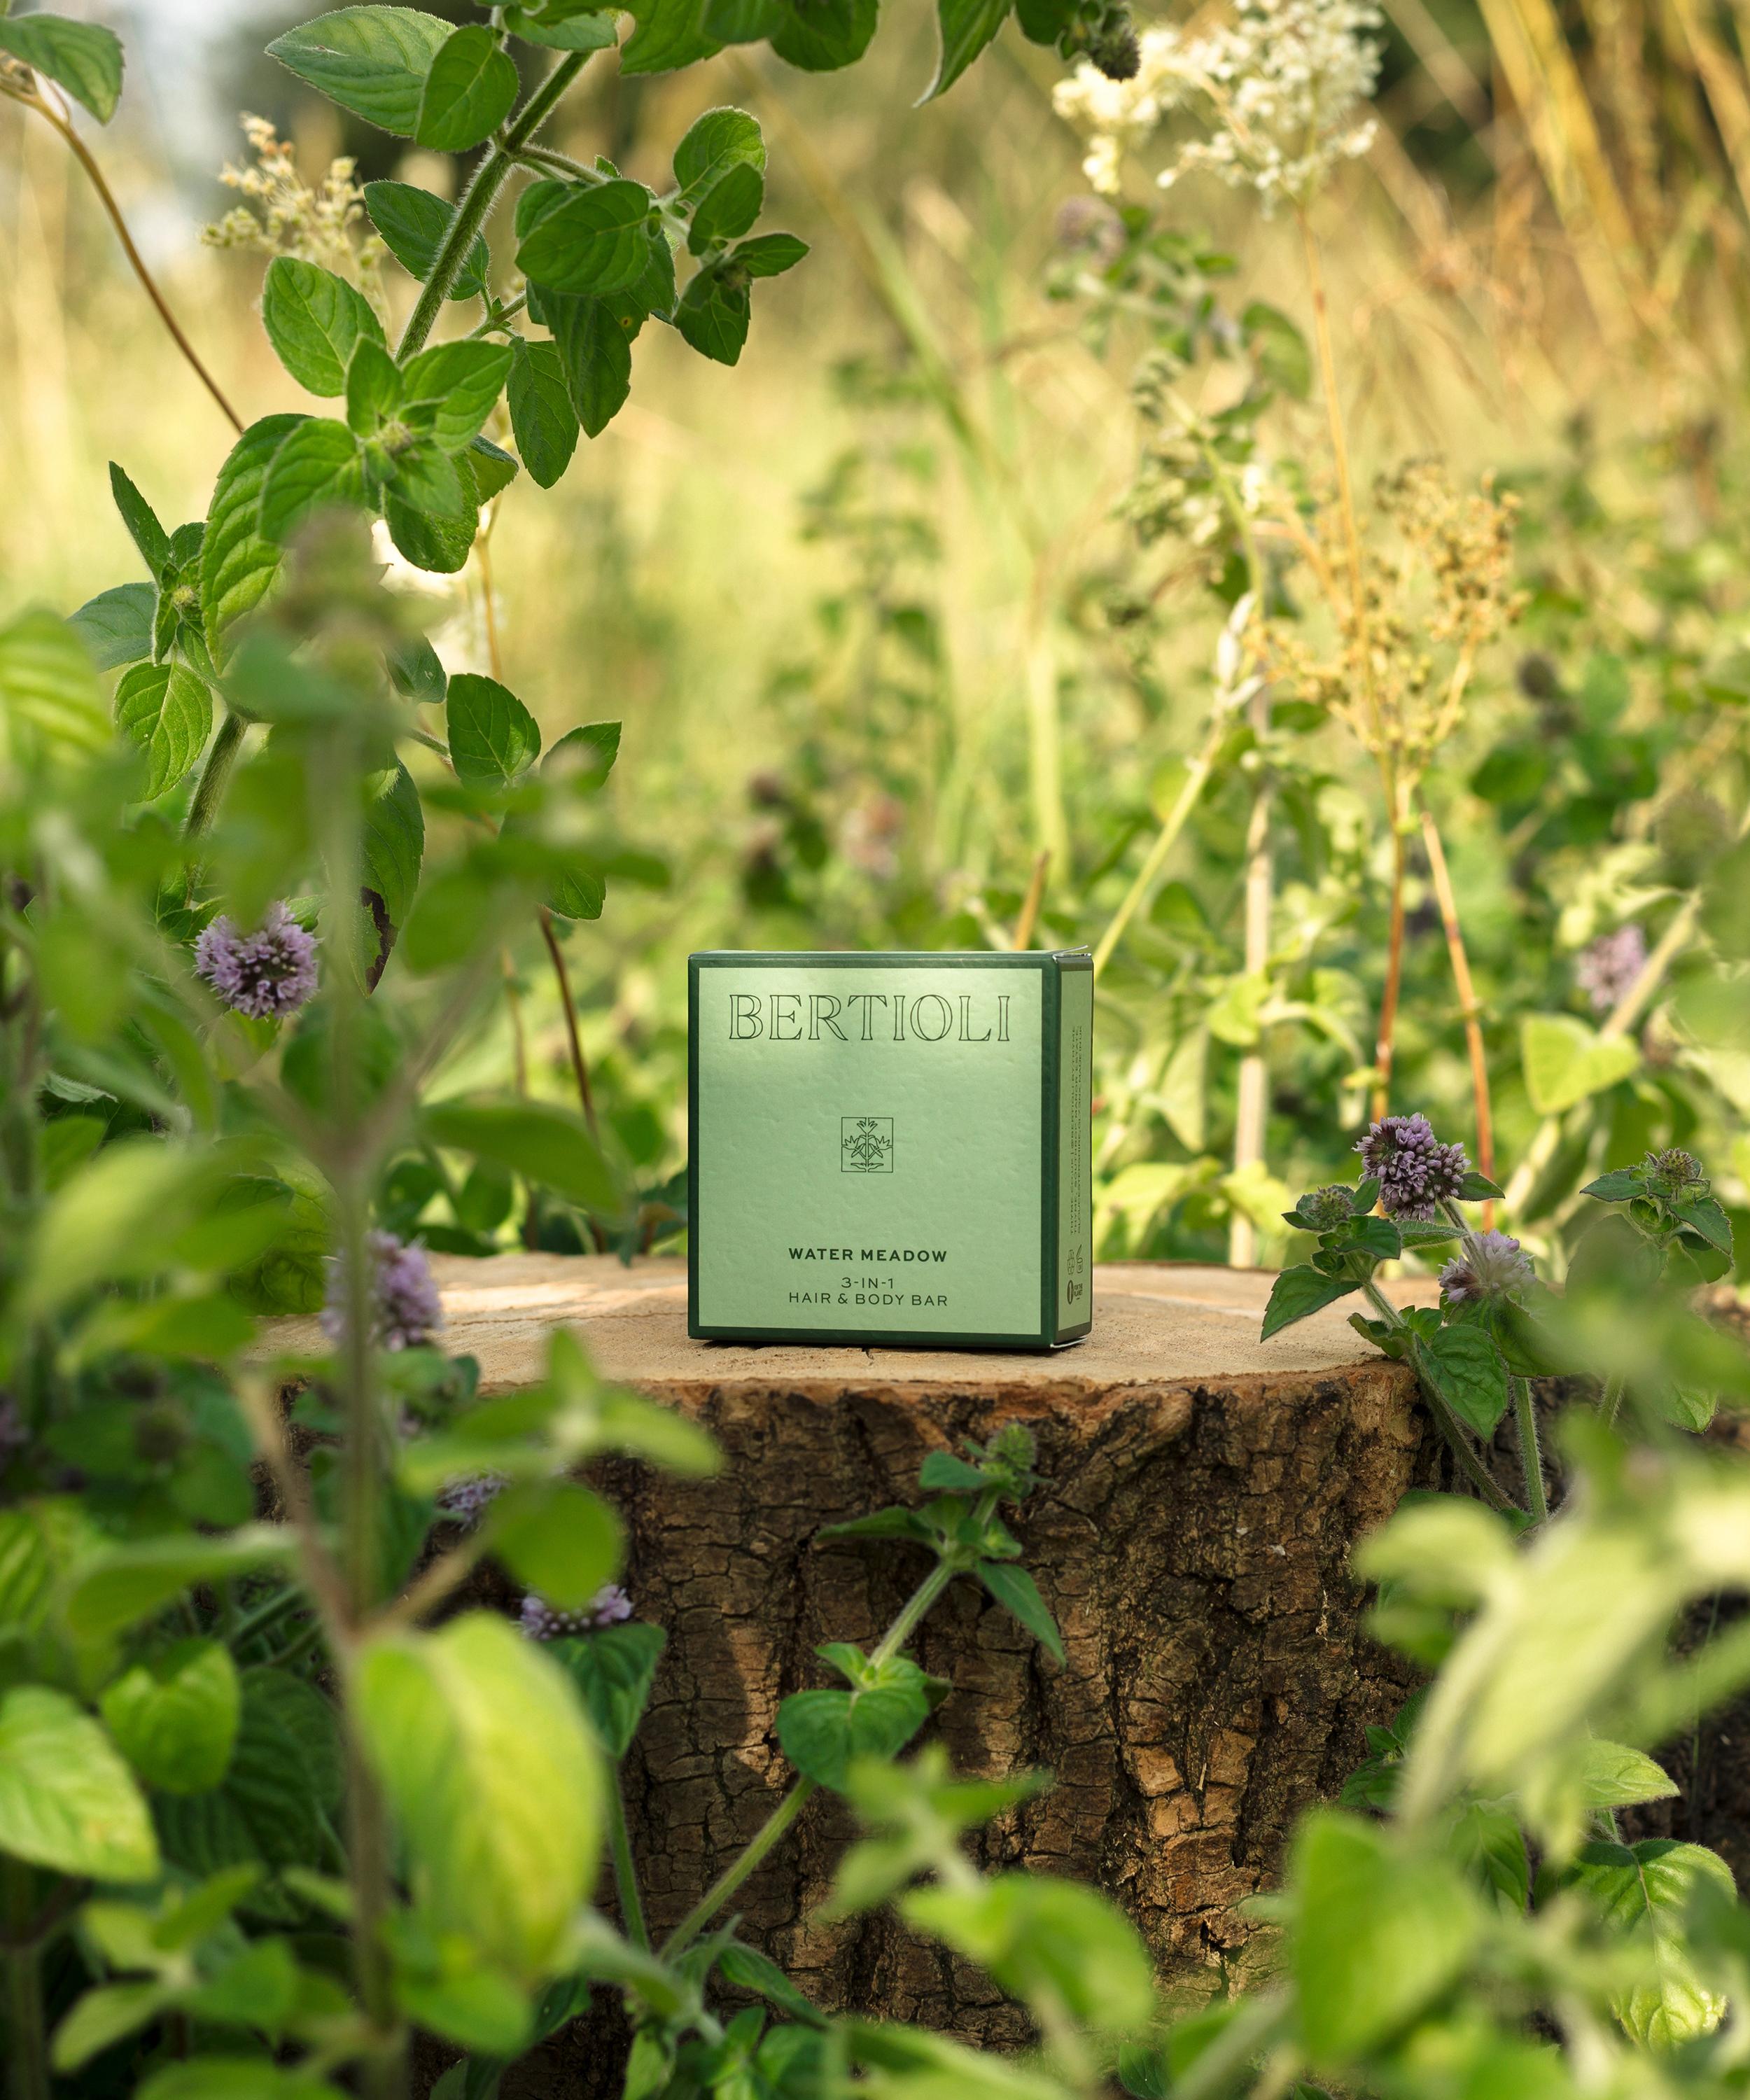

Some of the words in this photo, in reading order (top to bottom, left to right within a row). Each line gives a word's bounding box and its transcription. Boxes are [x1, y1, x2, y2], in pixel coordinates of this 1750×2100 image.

[729, 994, 1010, 1042] BERTIOLI
[788, 1248, 853, 1261] WATER
[861, 1250, 947, 1262] MEADOW
[841, 1277, 894, 1289] 3-IN-1
[789, 1292, 831, 1304] HAIR
[837, 1293, 848, 1305] &
[855, 1294, 904, 1306] BODY
[911, 1295, 947, 1306] BAR
